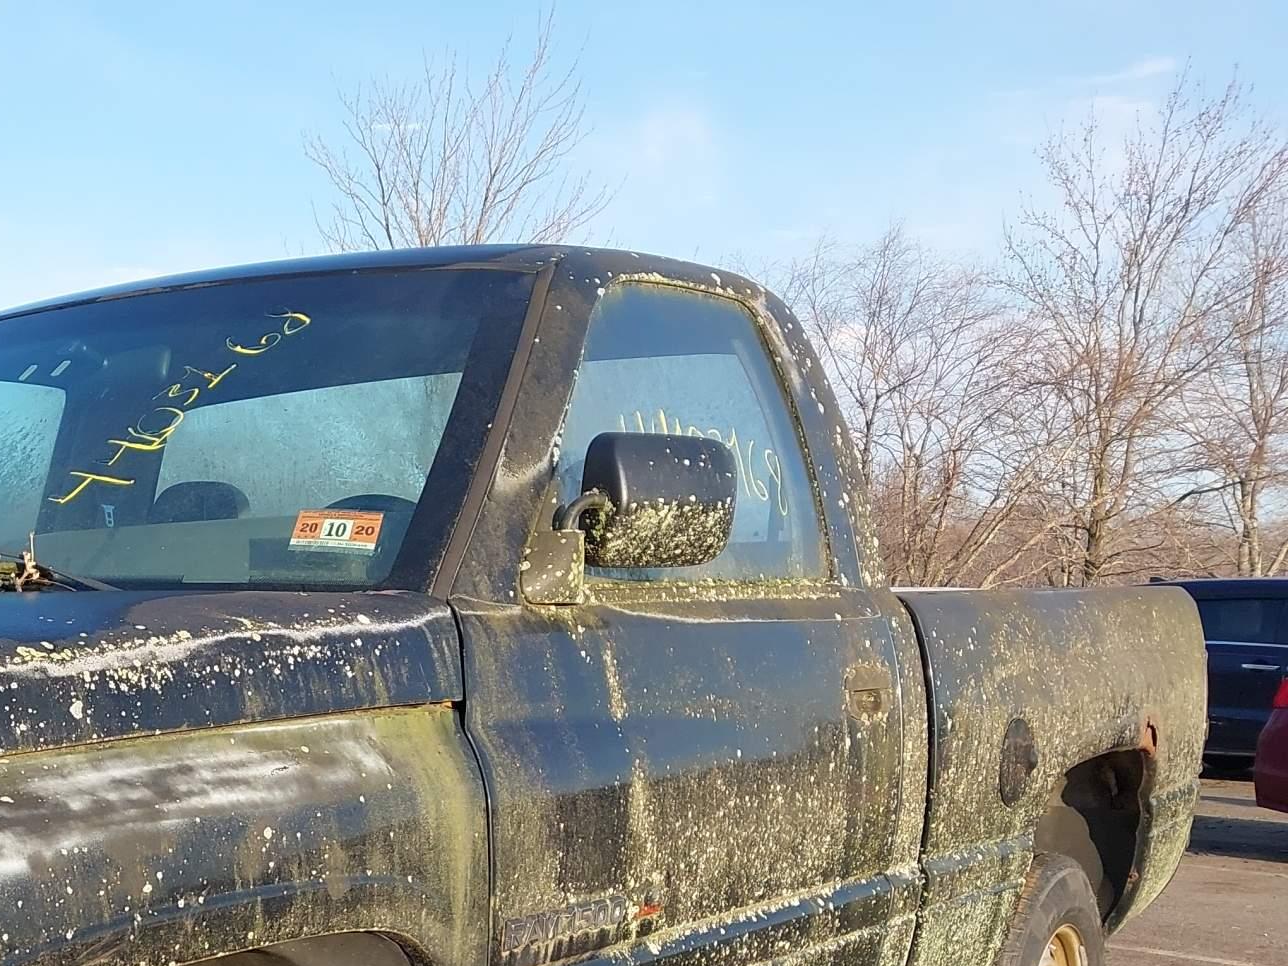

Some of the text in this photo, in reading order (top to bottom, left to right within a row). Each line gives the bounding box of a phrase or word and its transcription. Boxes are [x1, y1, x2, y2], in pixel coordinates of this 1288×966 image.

[300, 522, 375, 537] 20 10 20
